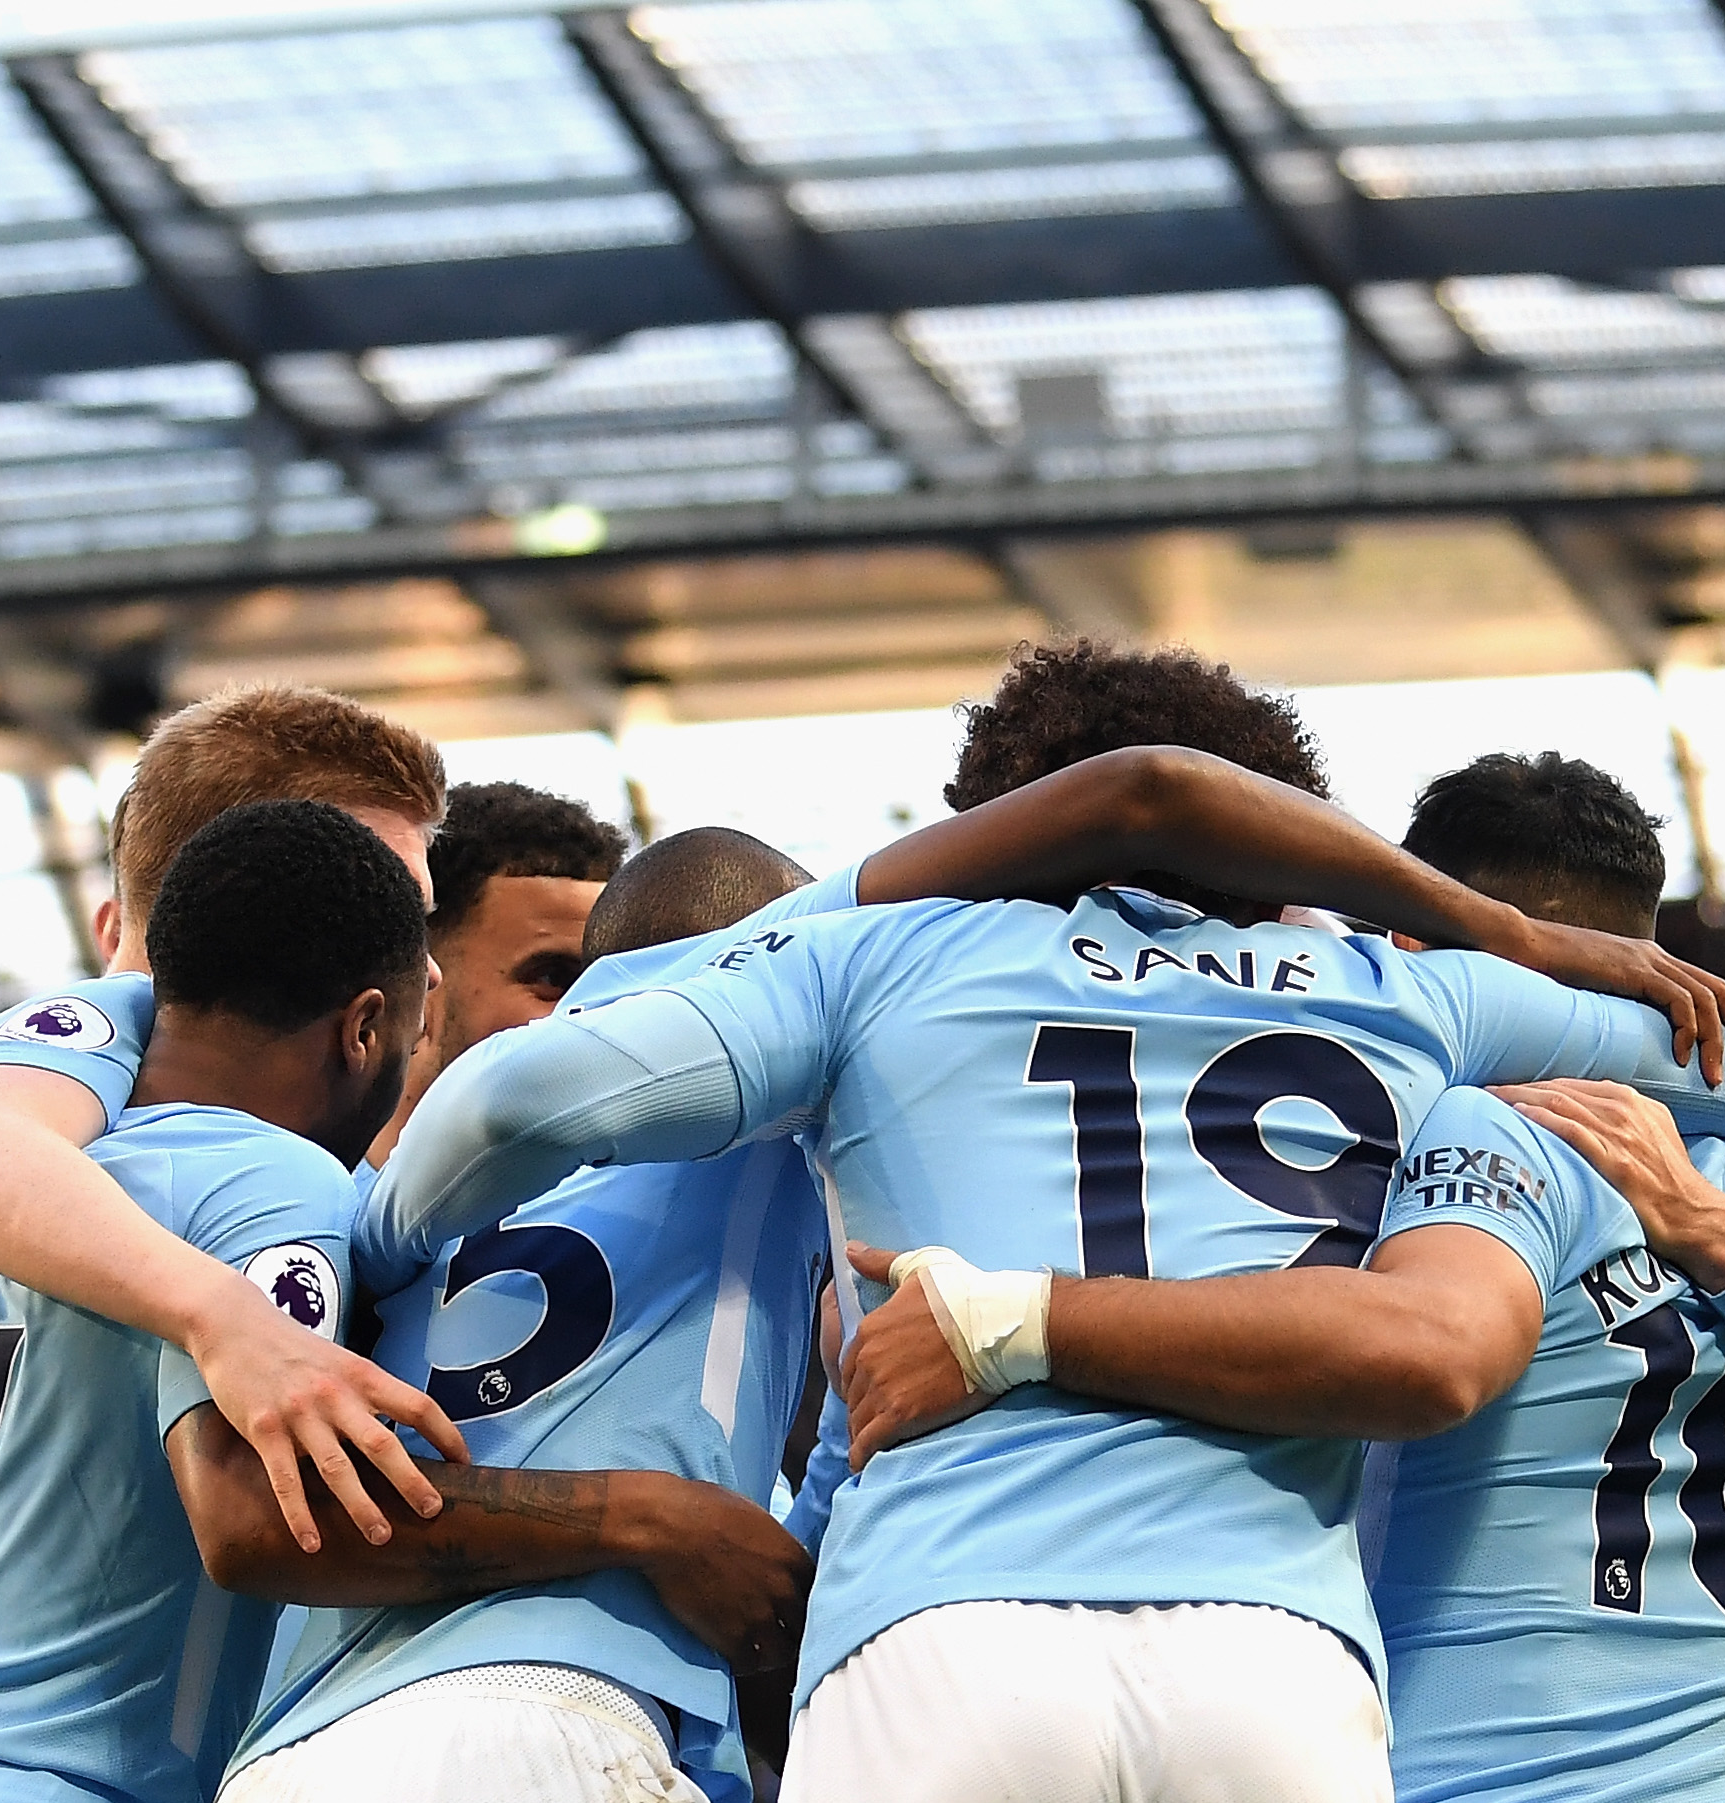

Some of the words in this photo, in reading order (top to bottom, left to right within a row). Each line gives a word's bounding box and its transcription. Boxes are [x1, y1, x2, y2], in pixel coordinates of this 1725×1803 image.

[1069, 937, 1317, 994] SANÉ
[1023, 1022, 1403, 1282] 19
[1398, 1146, 1546, 1201] NEXEN
[386, 1222, 615, 1430] 5
[1577, 1246, 1678, 1331] KU
